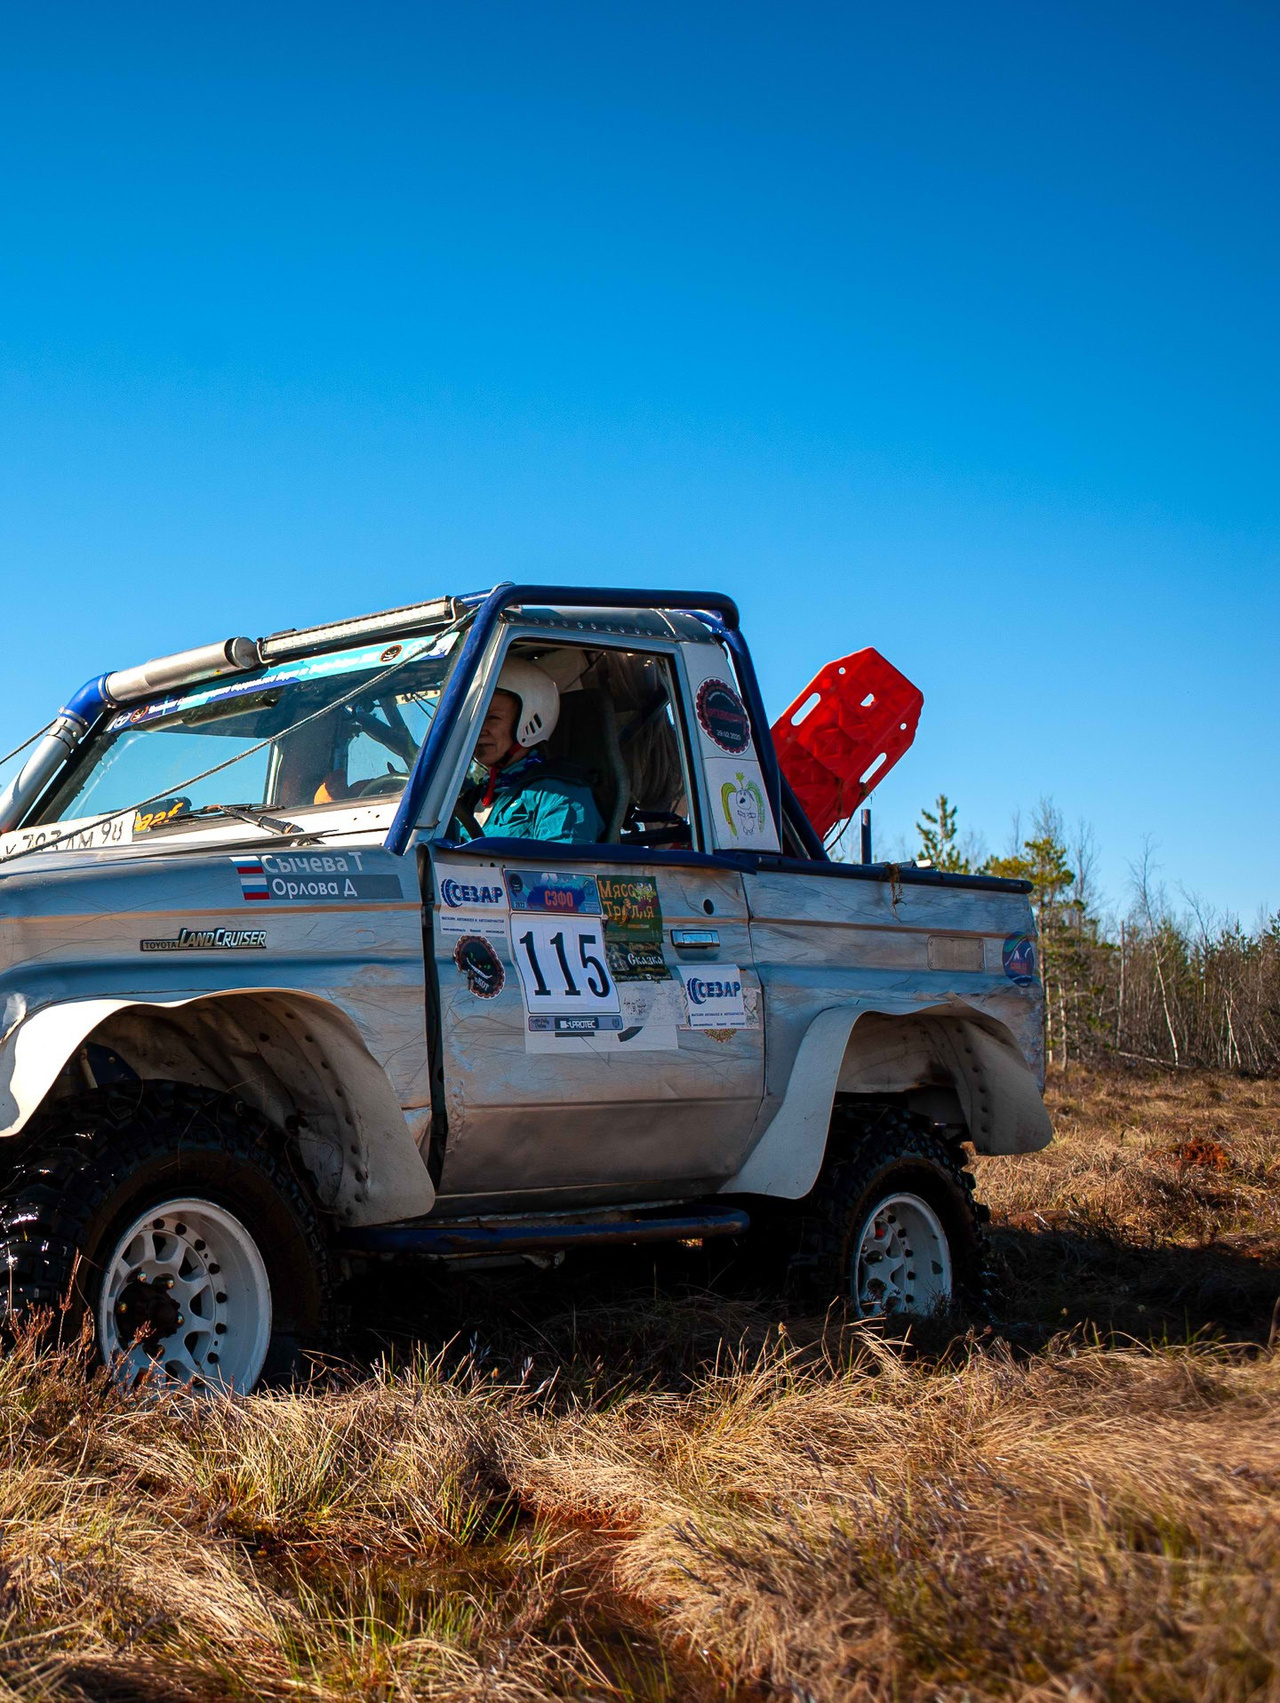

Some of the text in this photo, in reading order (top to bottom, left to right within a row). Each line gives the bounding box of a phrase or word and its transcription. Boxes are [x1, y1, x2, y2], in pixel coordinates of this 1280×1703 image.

[260, 852, 363, 874] Сычева Т
[272, 878, 358, 899] Орлова Д
[544, 889, 574, 908] СЗФО
[144, 941, 177, 949] TOYOTA
[519, 931, 611, 998] 115
